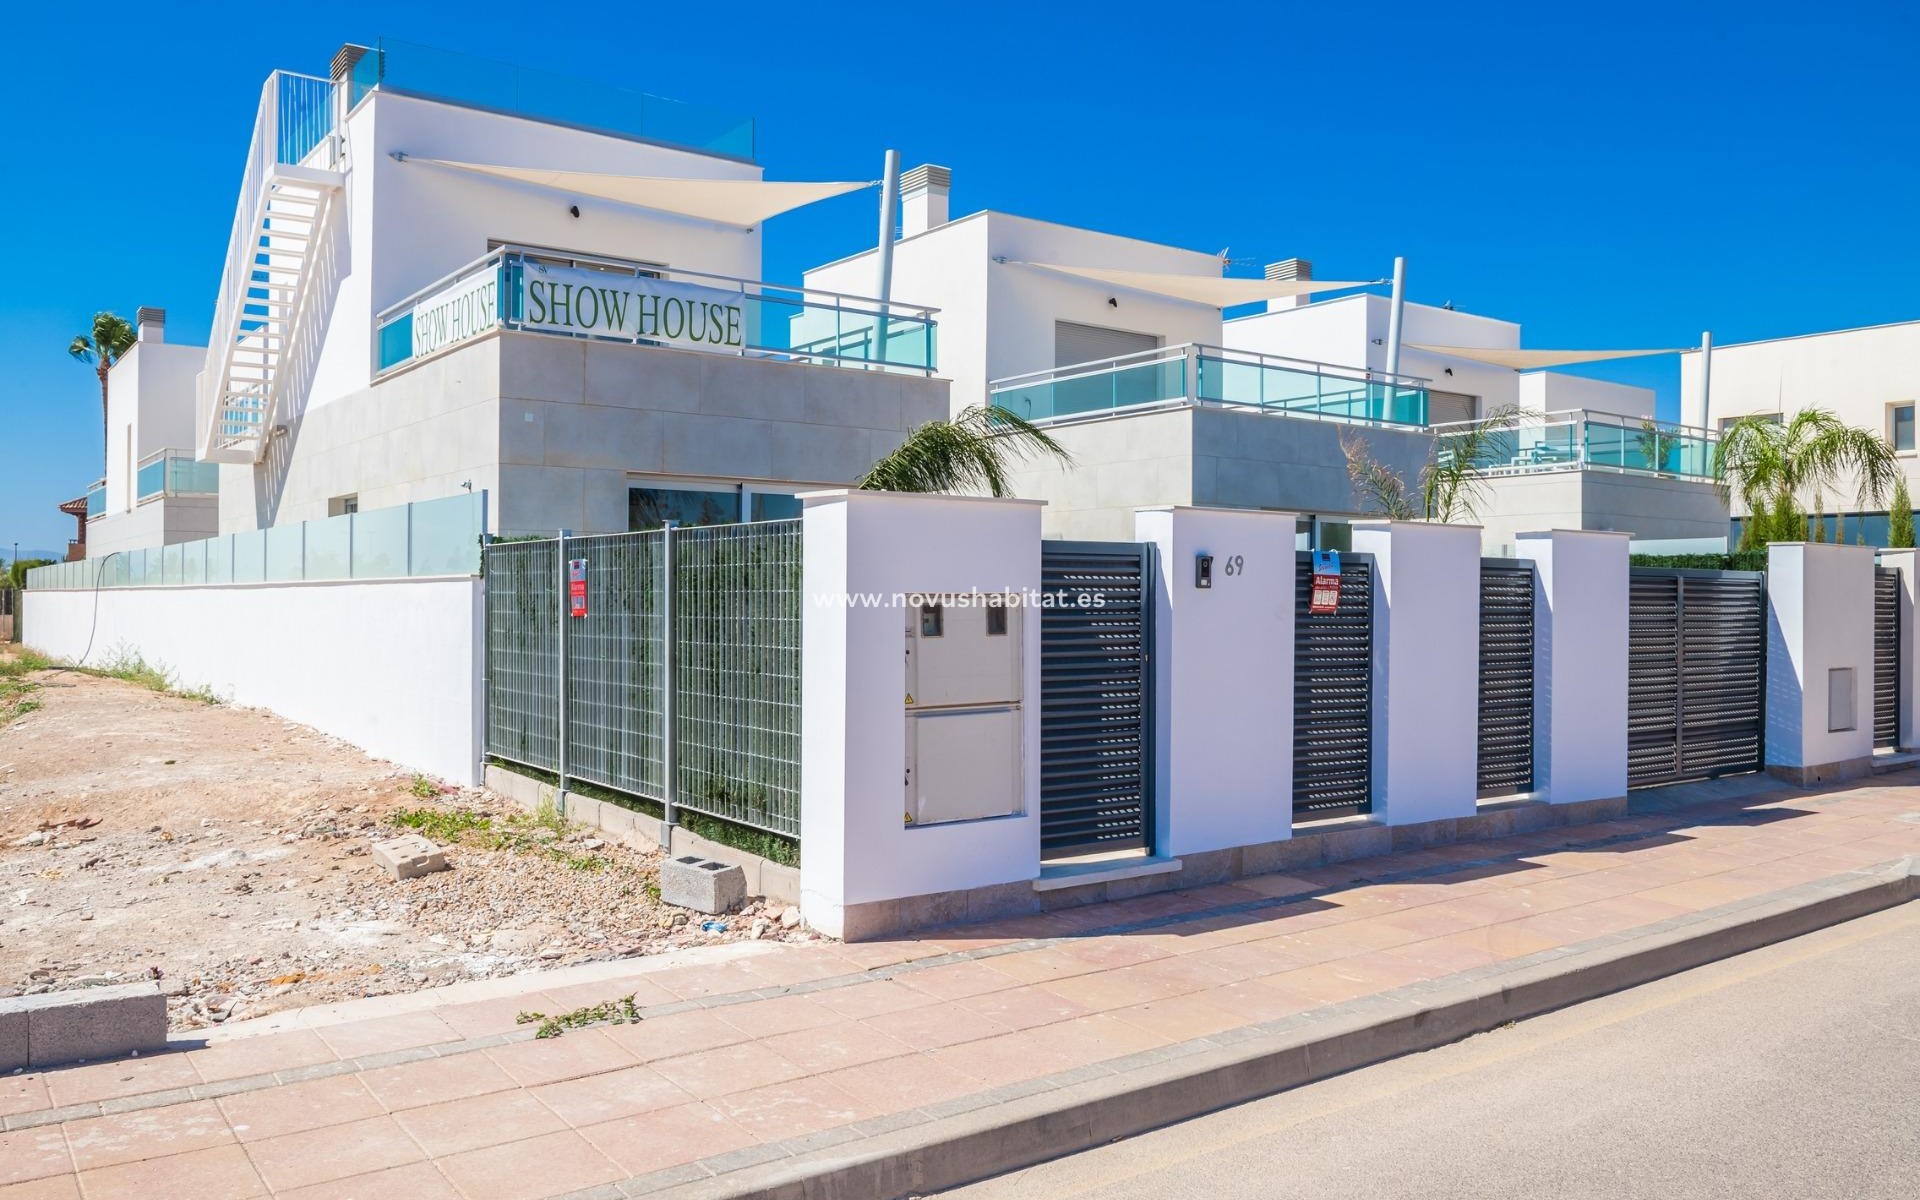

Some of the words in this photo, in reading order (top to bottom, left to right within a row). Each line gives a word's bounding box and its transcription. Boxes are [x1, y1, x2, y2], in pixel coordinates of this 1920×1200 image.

[415, 303, 449, 359] SHOW
[450, 281, 495, 343] HOUSE
[529, 279, 630, 332] SHOW
[636, 293, 742, 346] HOUSE
[1225, 555, 1244, 577] 69
[1315, 575, 1339, 586] Alarma
